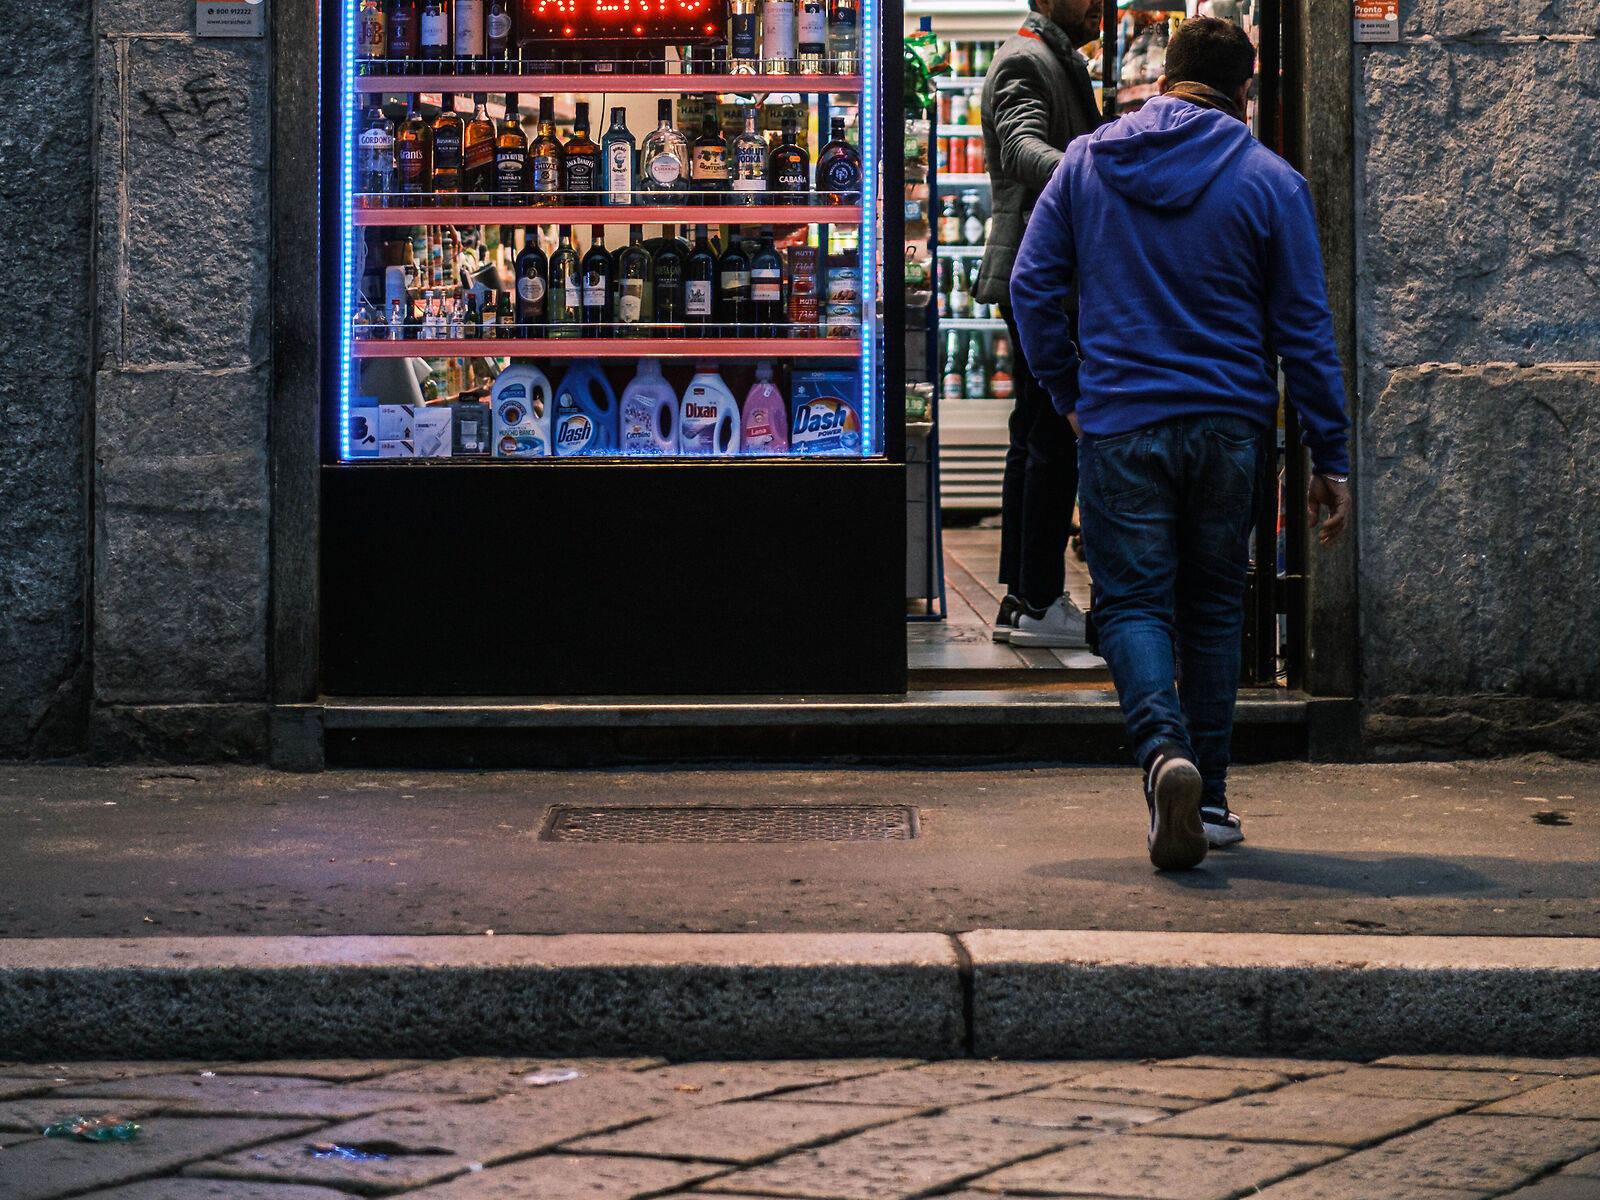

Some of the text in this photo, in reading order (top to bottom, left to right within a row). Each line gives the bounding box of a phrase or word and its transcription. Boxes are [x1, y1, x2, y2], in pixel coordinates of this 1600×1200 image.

[1355, 5, 1383, 13] Pronto
[685, 402, 717, 418] Dixan
[793, 401, 847, 435] Dash
[558, 420, 591, 443] Dash
[817, 428, 842, 438] POWER
